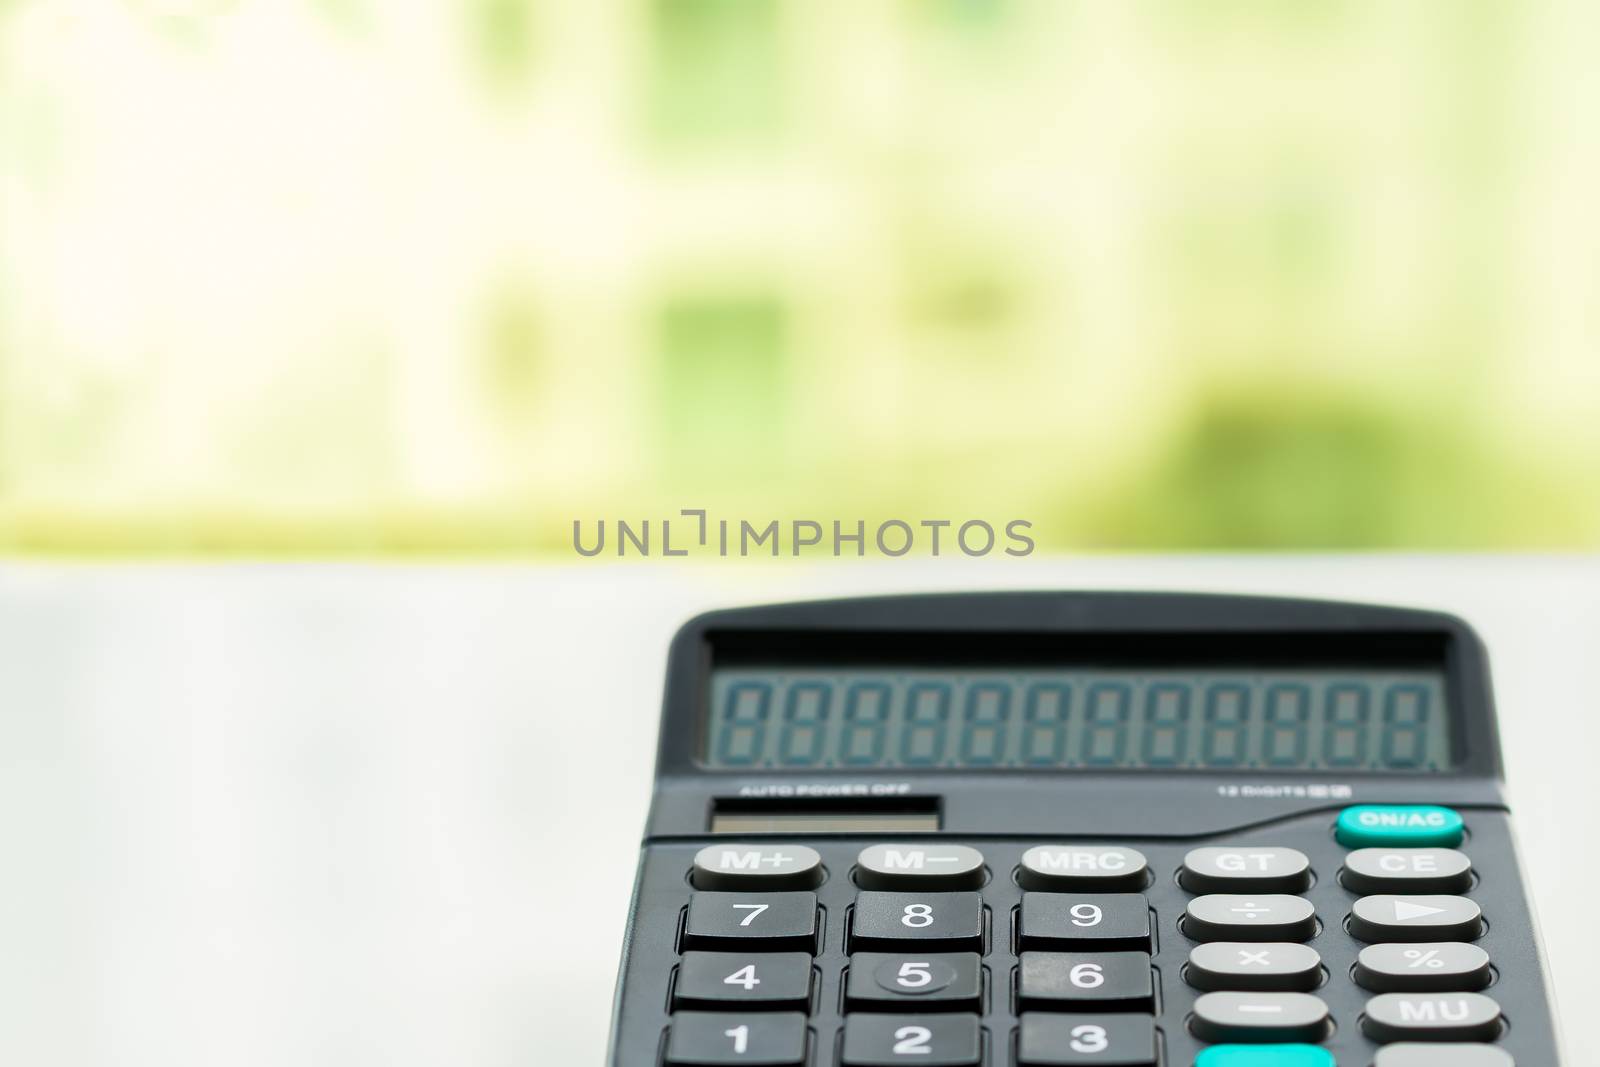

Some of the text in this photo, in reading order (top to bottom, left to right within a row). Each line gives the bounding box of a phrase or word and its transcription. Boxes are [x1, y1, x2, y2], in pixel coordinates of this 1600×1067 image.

[739, 782, 911, 797] AUTO POWER OFF
[1359, 811, 1446, 828] ON/AC
[720, 849, 793, 868] M+
[1039, 851, 1126, 870] MRC
[1215, 853, 1276, 872] GT
[1379, 854, 1438, 873] CE
[732, 903, 769, 926] 7
[900, 903, 934, 928] 8
[1069, 903, 1103, 927] 9
[723, 964, 761, 990] 4
[896, 962, 932, 988] 5
[1069, 964, 1105, 988] 6
[1399, 1000, 1470, 1022] MU
[724, 1024, 749, 1053] 1
[892, 1026, 932, 1054] 2
[1069, 1025, 1108, 1053] 3
